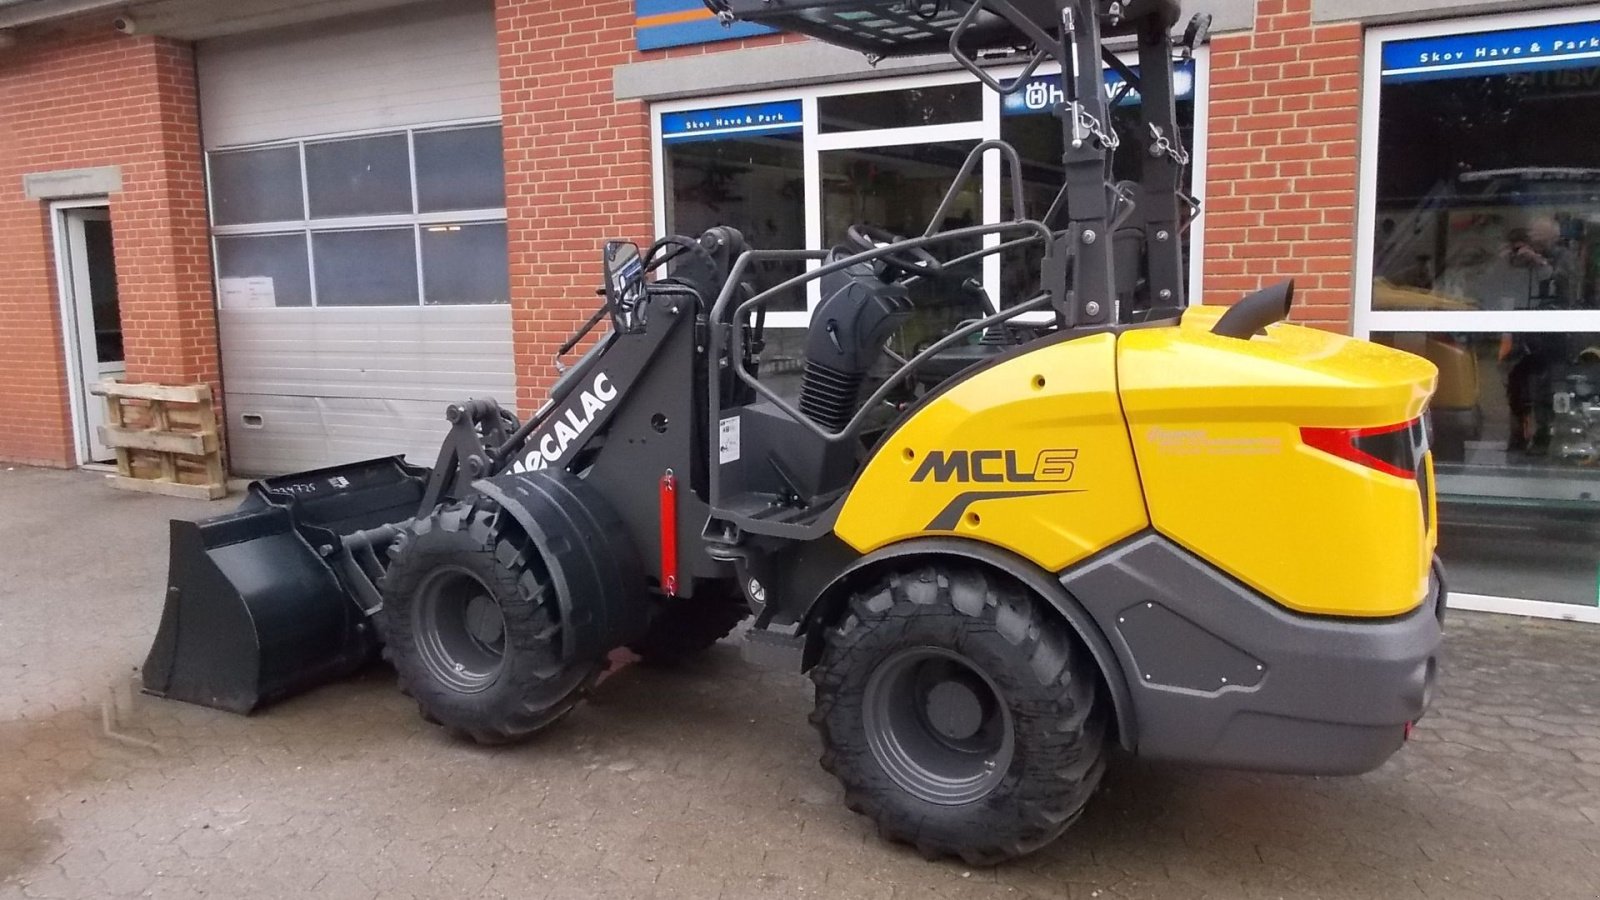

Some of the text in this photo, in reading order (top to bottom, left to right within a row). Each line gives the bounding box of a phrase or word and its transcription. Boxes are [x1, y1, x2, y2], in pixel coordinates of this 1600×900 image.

[1419, 37, 1600, 63] Skov Have & Park
[686, 113, 784, 129] Skov Have & Park
[505, 372, 618, 475] eCALAC
[909, 449, 1079, 483] MCL6
